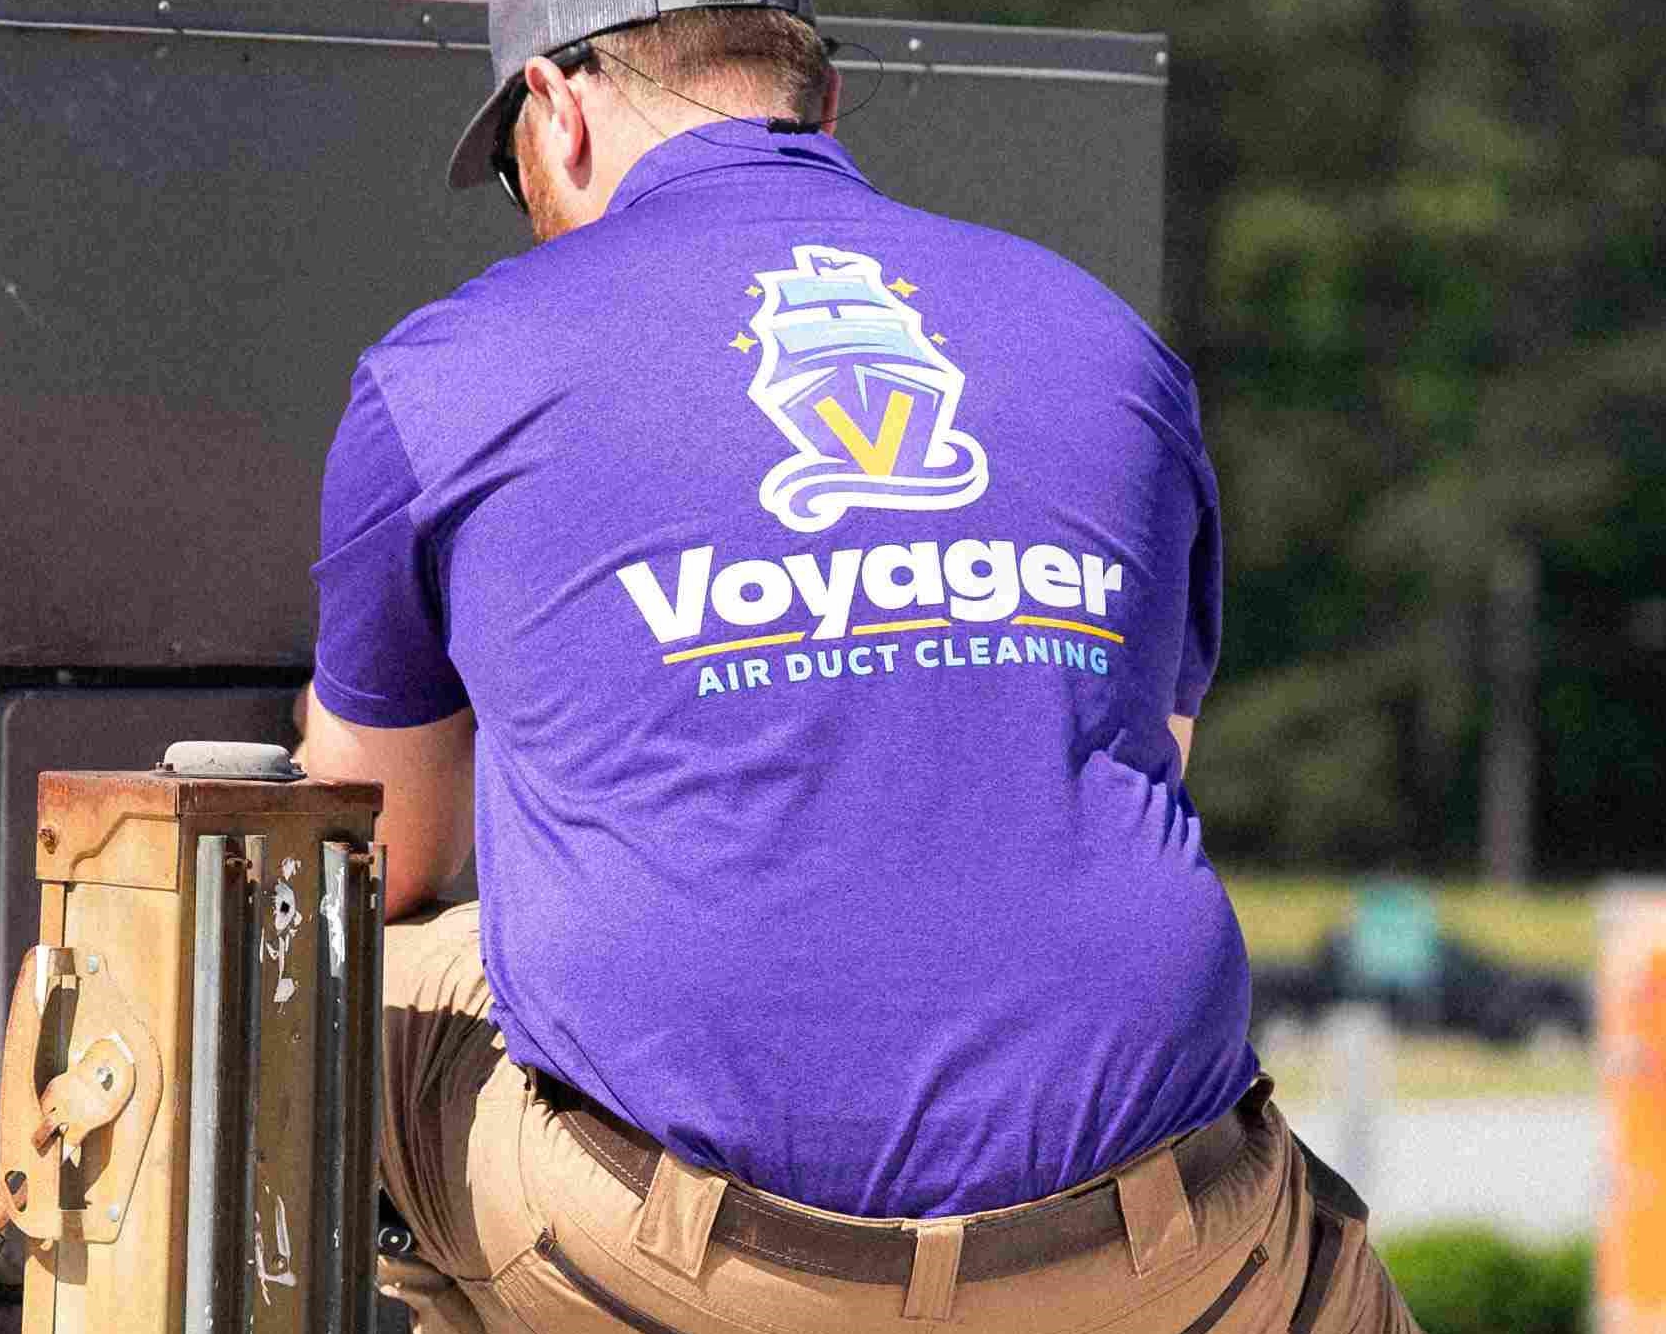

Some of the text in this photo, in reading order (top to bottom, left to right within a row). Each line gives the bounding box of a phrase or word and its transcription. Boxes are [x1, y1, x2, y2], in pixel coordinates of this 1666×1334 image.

[813, 389, 914, 476] V
[616, 539, 1123, 644] Voyager
[697, 636, 1109, 697] AIR DUCT CLEANING
